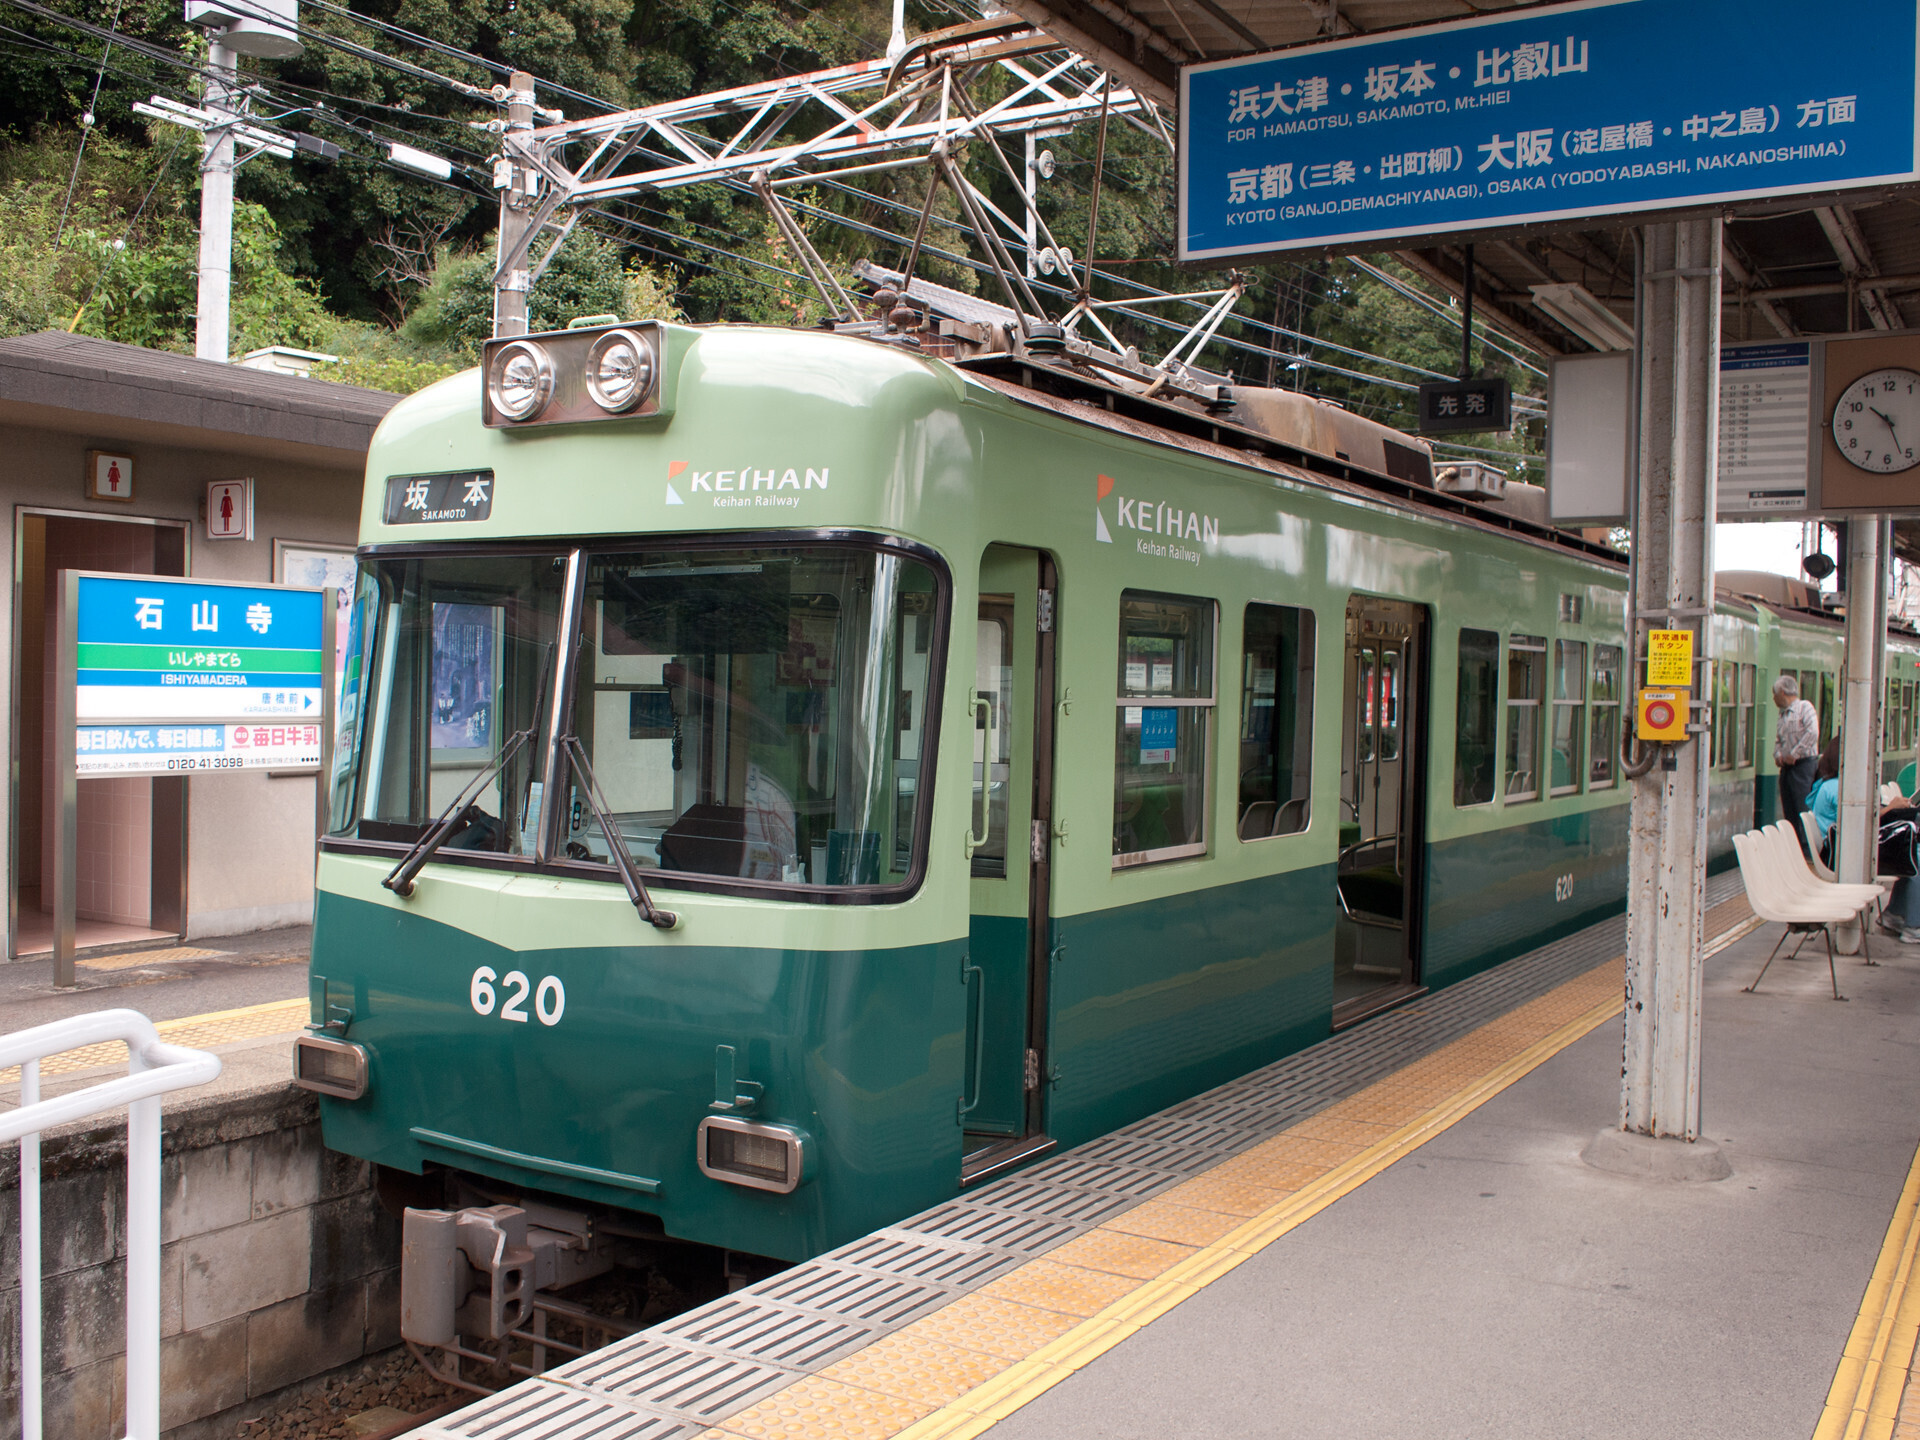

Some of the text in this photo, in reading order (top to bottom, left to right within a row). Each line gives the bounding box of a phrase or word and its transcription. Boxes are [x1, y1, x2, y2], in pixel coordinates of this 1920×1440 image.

[1227, 36, 1588, 124] 浜大津・坂本・比叡山
[1227, 90, 1511, 143] FOR HAMAOTSU, SAKAMOTO, Mt.HIEI
[1796, 95, 1857, 128] 方面
[1226, 207, 1276, 226] KYOTO
[1487, 176, 1546, 195] OSAKA
[1551, 159, 1691, 189] (YODOYABASHI,
[1696, 139, 1847, 171] NAKANOSHIMA)
[1864, 387, 1875, 397] 11
[1883, 381, 1896, 392] 12
[1907, 384, 1913, 394] 1
[1850, 402, 1863, 412] 10
[1844, 420, 1852, 430] 9
[1850, 438, 1857, 448] 8
[1864, 451, 1872, 461] 7
[1883, 455, 1891, 464] 6
[1905, 448, 1913, 458] 5
[404, 475, 490, 510] 坂本
[713, 494, 800, 508] Keihan Railway
[421, 508, 466, 520] SAKAMOTO
[1137, 538, 1201, 566] Keihan Railway
[134, 597, 272, 634] 石山寺
[168, 651, 241, 667] いしやまでら
[161, 673, 248, 685] ISHIYAMADERA
[1556, 873, 1574, 902] 620
[470, 965, 565, 1026] 620
